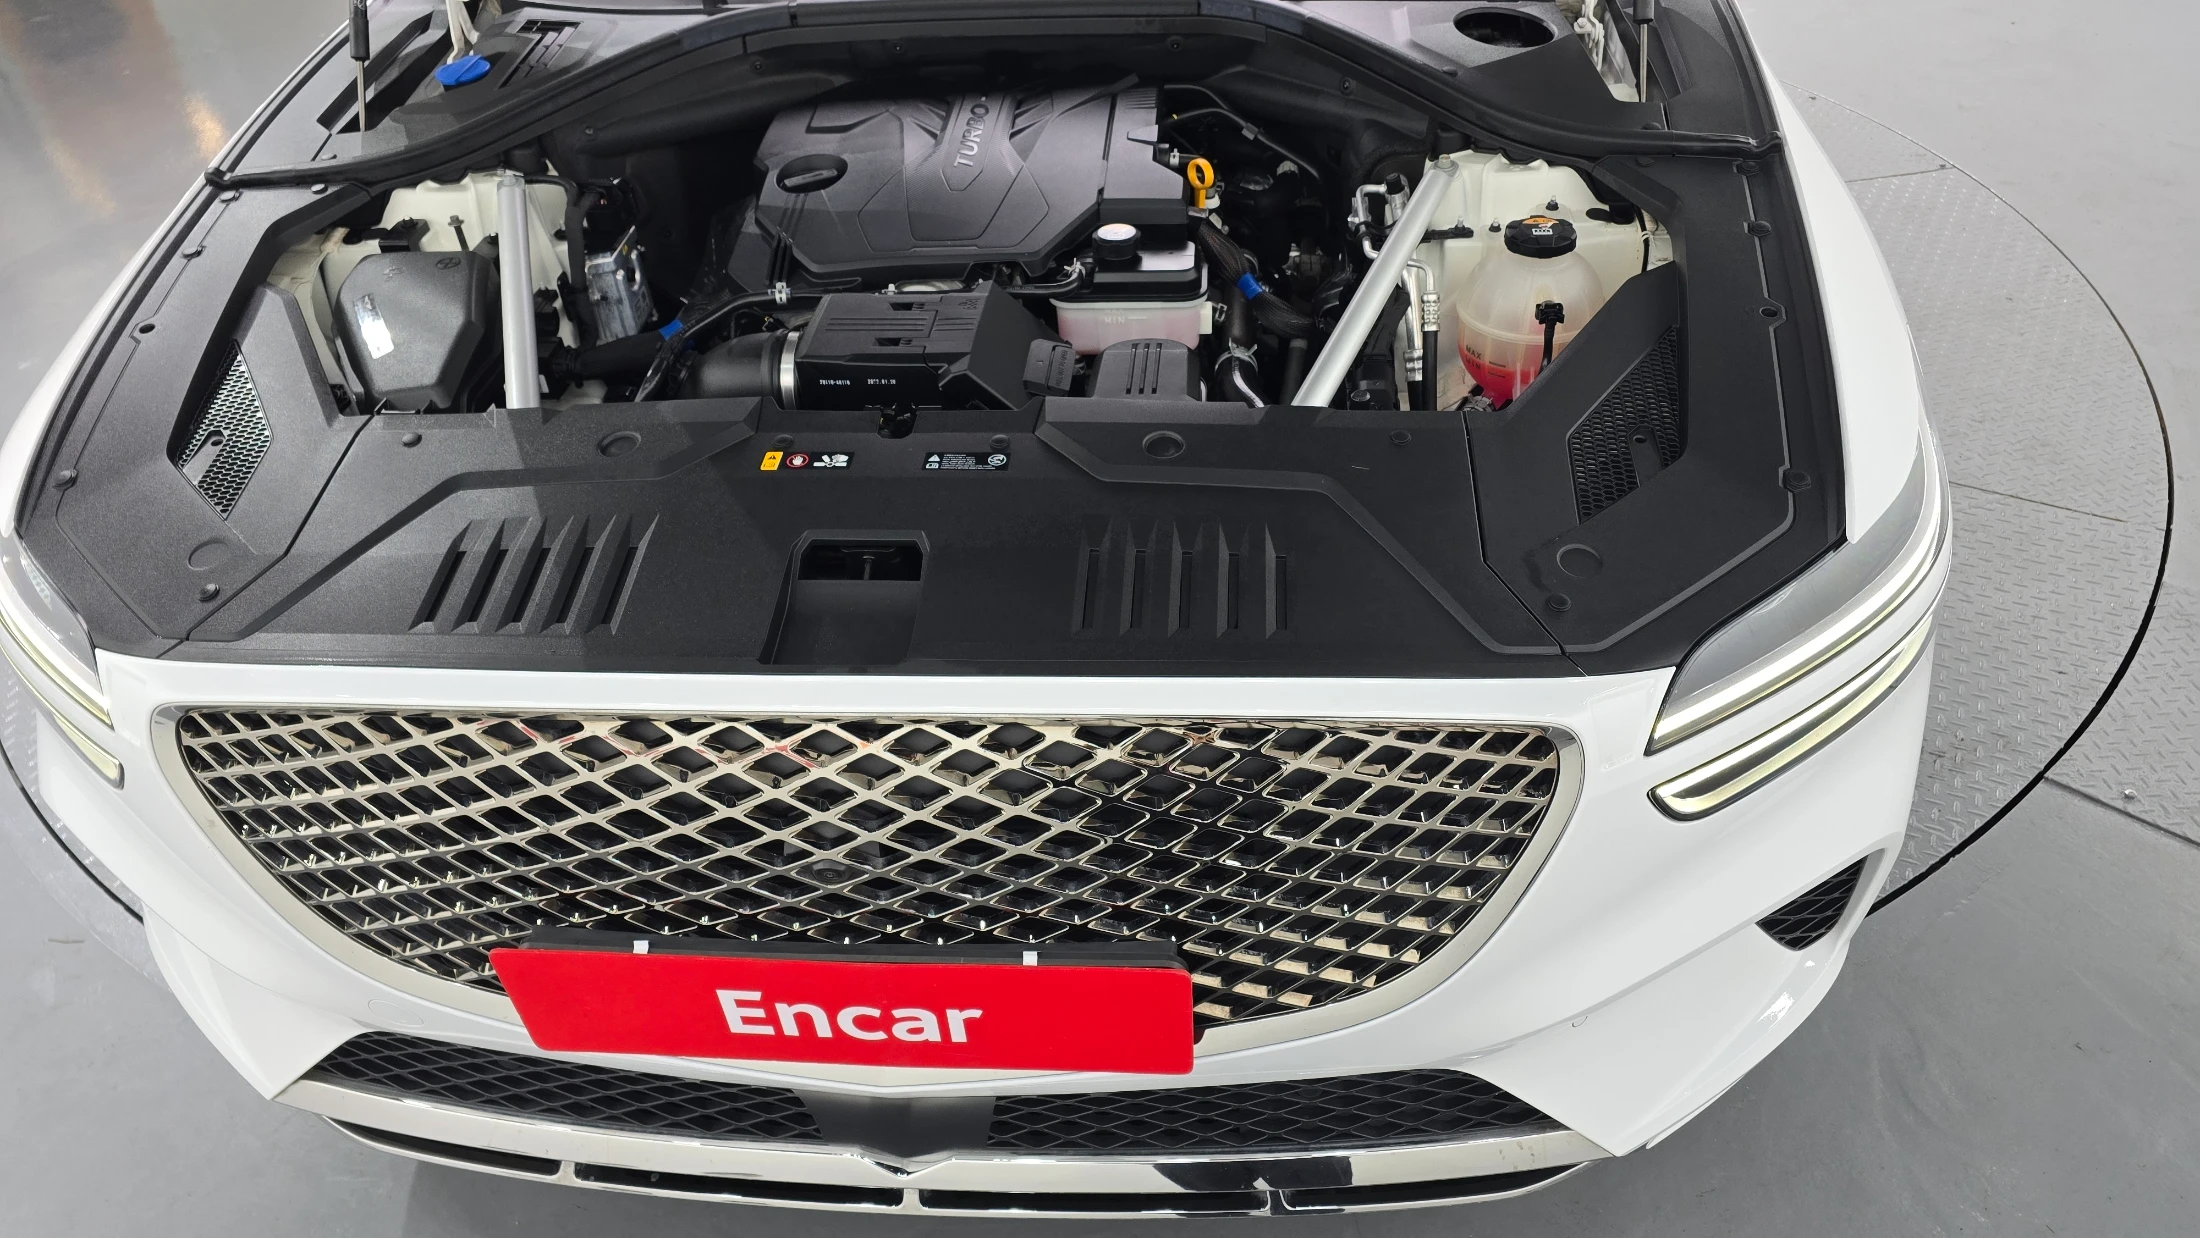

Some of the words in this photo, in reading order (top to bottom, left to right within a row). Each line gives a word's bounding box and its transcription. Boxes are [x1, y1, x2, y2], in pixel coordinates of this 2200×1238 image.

[1104, 316, 1125, 325] MIN
[1465, 344, 1482, 360] MAX
[1465, 355, 1481, 370] MIN
[715, 989, 984, 1043] Encar
